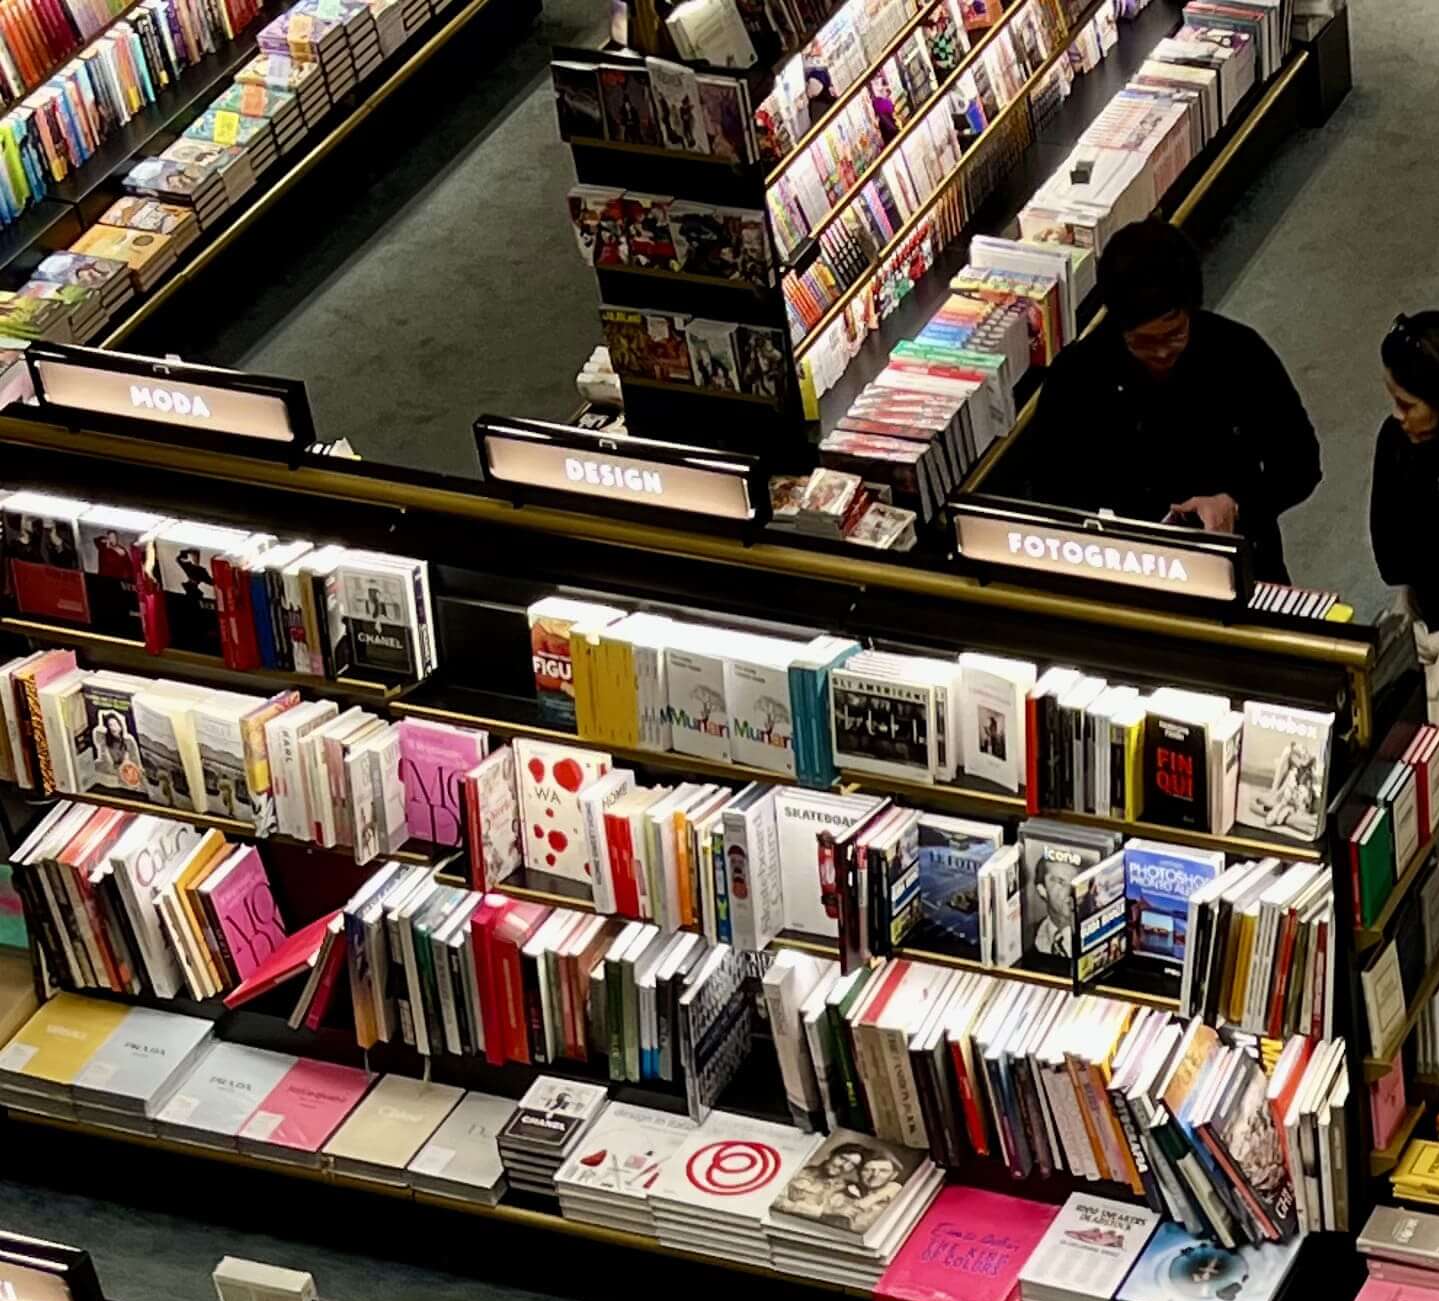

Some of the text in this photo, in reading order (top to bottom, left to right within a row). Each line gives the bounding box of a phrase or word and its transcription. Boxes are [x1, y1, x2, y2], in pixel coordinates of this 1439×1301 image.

[129, 385, 210, 418] MODA
[565, 459, 664, 494] DESIGN
[1007, 531, 1189, 582] FOTOGRAFIA
[357, 632, 403, 650] CHANEL
[670, 710, 730, 738] Munari
[734, 718, 792, 749] Munari
[1156, 747, 1193, 774] FIN
[1156, 770, 1193, 800] QUI
[520, 1114, 566, 1133] CHANEL
